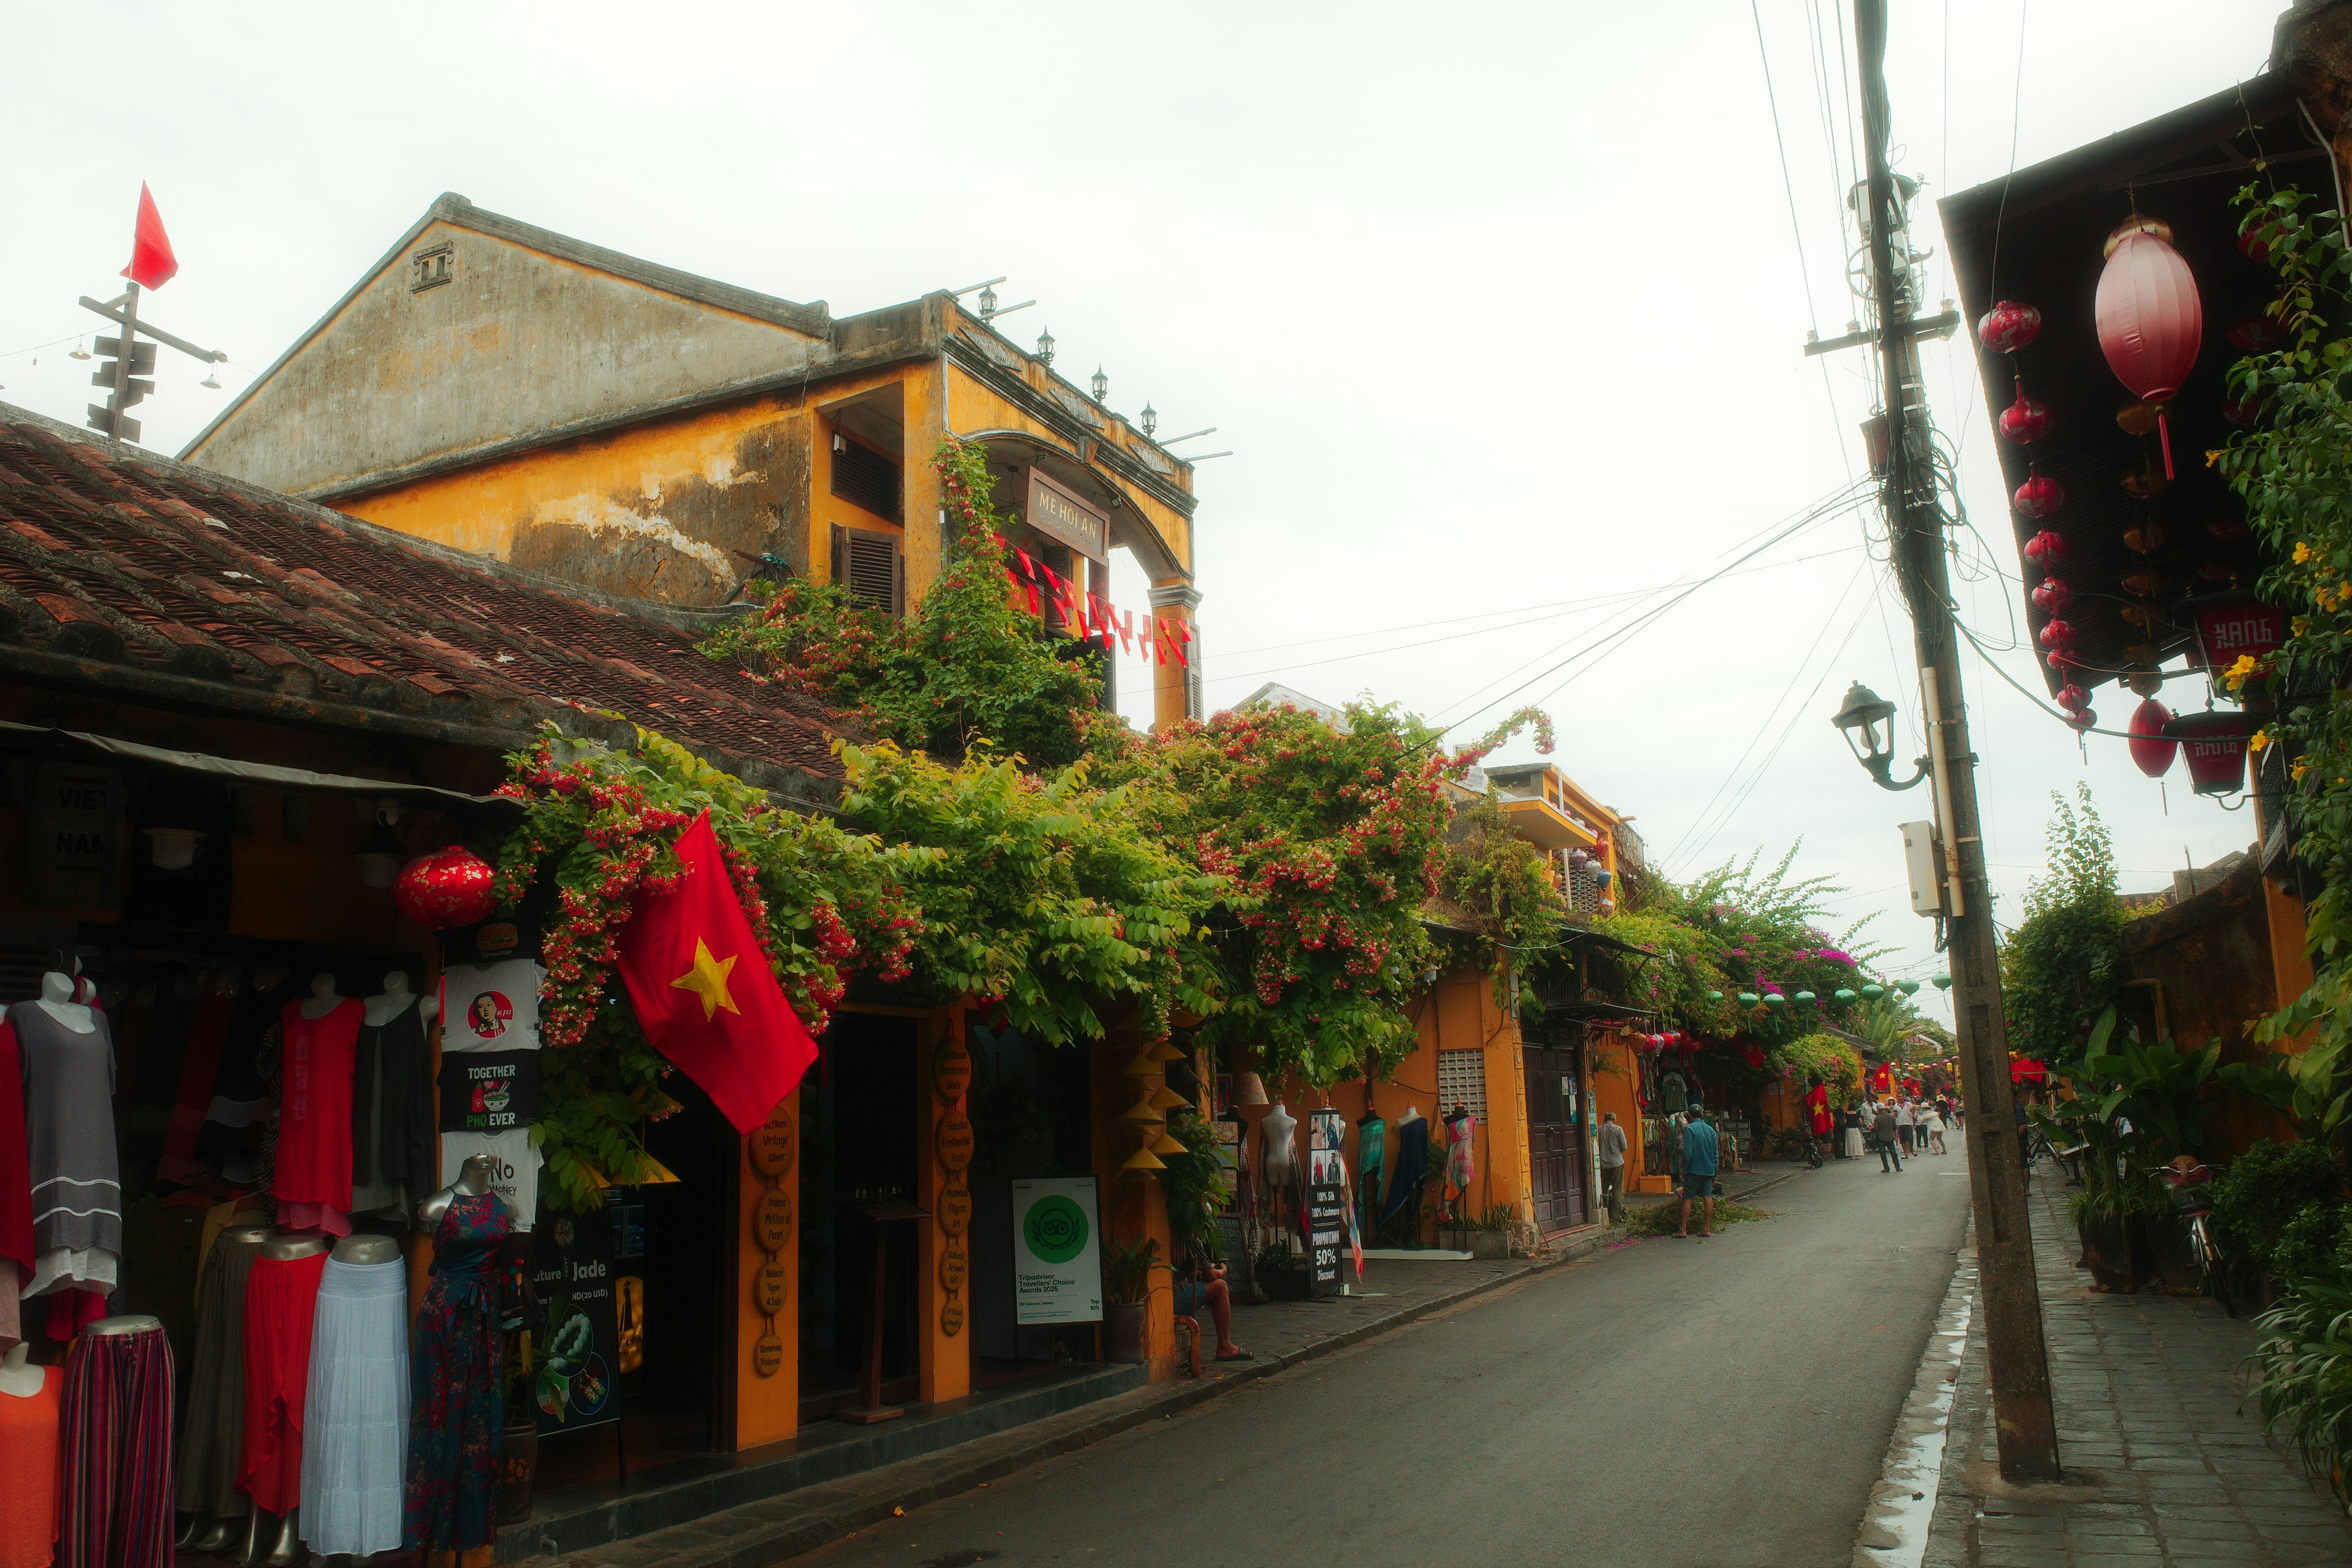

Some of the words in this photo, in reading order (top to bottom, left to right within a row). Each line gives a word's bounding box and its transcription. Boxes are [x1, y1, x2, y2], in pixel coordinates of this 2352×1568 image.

[1040, 490, 1057, 515] MÊ
[1059, 503, 1078, 528] HỘI
[1081, 517, 1097, 538] AN
[1041, 514, 1062, 528] ROOFTOP
[1085, 539, 1094, 548] BAR
[468, 1064, 516, 1079] TOGETHER
[946, 1079, 962, 1090] Silver
[466, 1114, 487, 1127] PHO
[489, 1112, 516, 1126] EVER
[947, 1120, 968, 1131] Selected
[763, 1135, 789, 1148] Vintage
[942, 1136, 971, 1149] Freshwater
[951, 1152, 964, 1163] Pearl
[947, 1188, 968, 1198] Historical
[1317, 1191, 1327, 1202] 100%
[769, 1197, 787, 1209] Unique
[948, 1203, 967, 1216] Filigree
[1312, 1207, 1322, 1218] 100%
[1323, 1206, 1340, 1217] Cashmere
[766, 1213, 785, 1225] Mother
[786, 1213, 791, 1225] of
[769, 1229, 783, 1240] Pearl
[1312, 1230, 1339, 1246] PROMOTION
[949, 1250, 964, 1260] Cultural
[1316, 1248, 1336, 1266] 50%
[573, 1259, 607, 1282] Jade
[766, 1268, 784, 1278] Natural
[948, 1263, 964, 1272] Artwork
[1318, 1269, 1335, 1281] Discount
[593, 1288, 609, 1299] USD)
[768, 1283, 780, 1295] Type
[765, 1297, 770, 1307] A
[771, 1297, 782, 1307] Jade
[947, 1308, 962, 1316] Artistic
